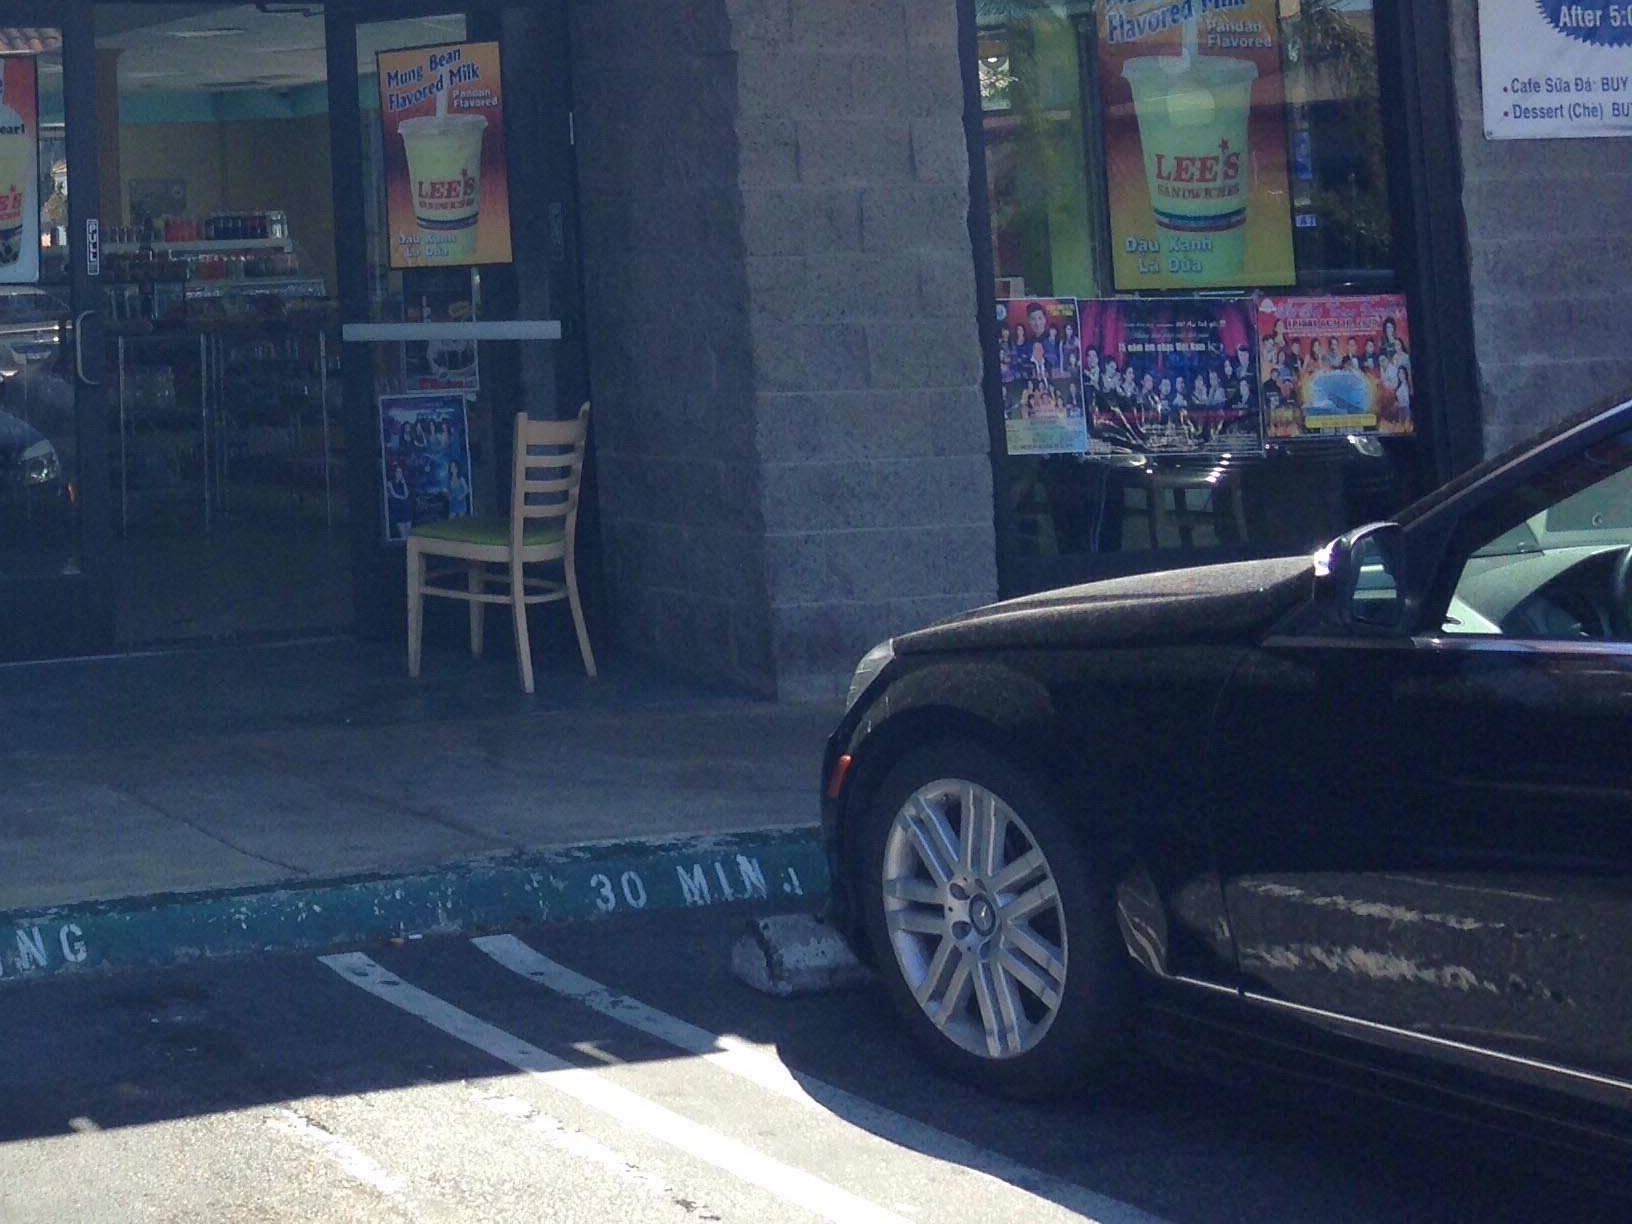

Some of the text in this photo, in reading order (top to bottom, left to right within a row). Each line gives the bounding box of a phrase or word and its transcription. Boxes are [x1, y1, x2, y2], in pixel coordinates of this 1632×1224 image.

[1559, 4, 1603, 28] After
[1207, 34, 1273, 48] Flavored
[387, 48, 461, 89] Mung Bean
[1510, 78, 1542, 94] Cafe
[1600, 75, 1629, 93] BUY
[388, 62, 481, 113] Flavored Milk
[454, 96, 498, 108] Flavored
[1512, 102, 1565, 120] Dessert
[1612, 102, 1632, 119] BU
[1155, 136, 1241, 183] LEE'S
[418, 168, 476, 201] LEE'S
[88, 223, 98, 263] PULL
[589, 869, 649, 913] 30
